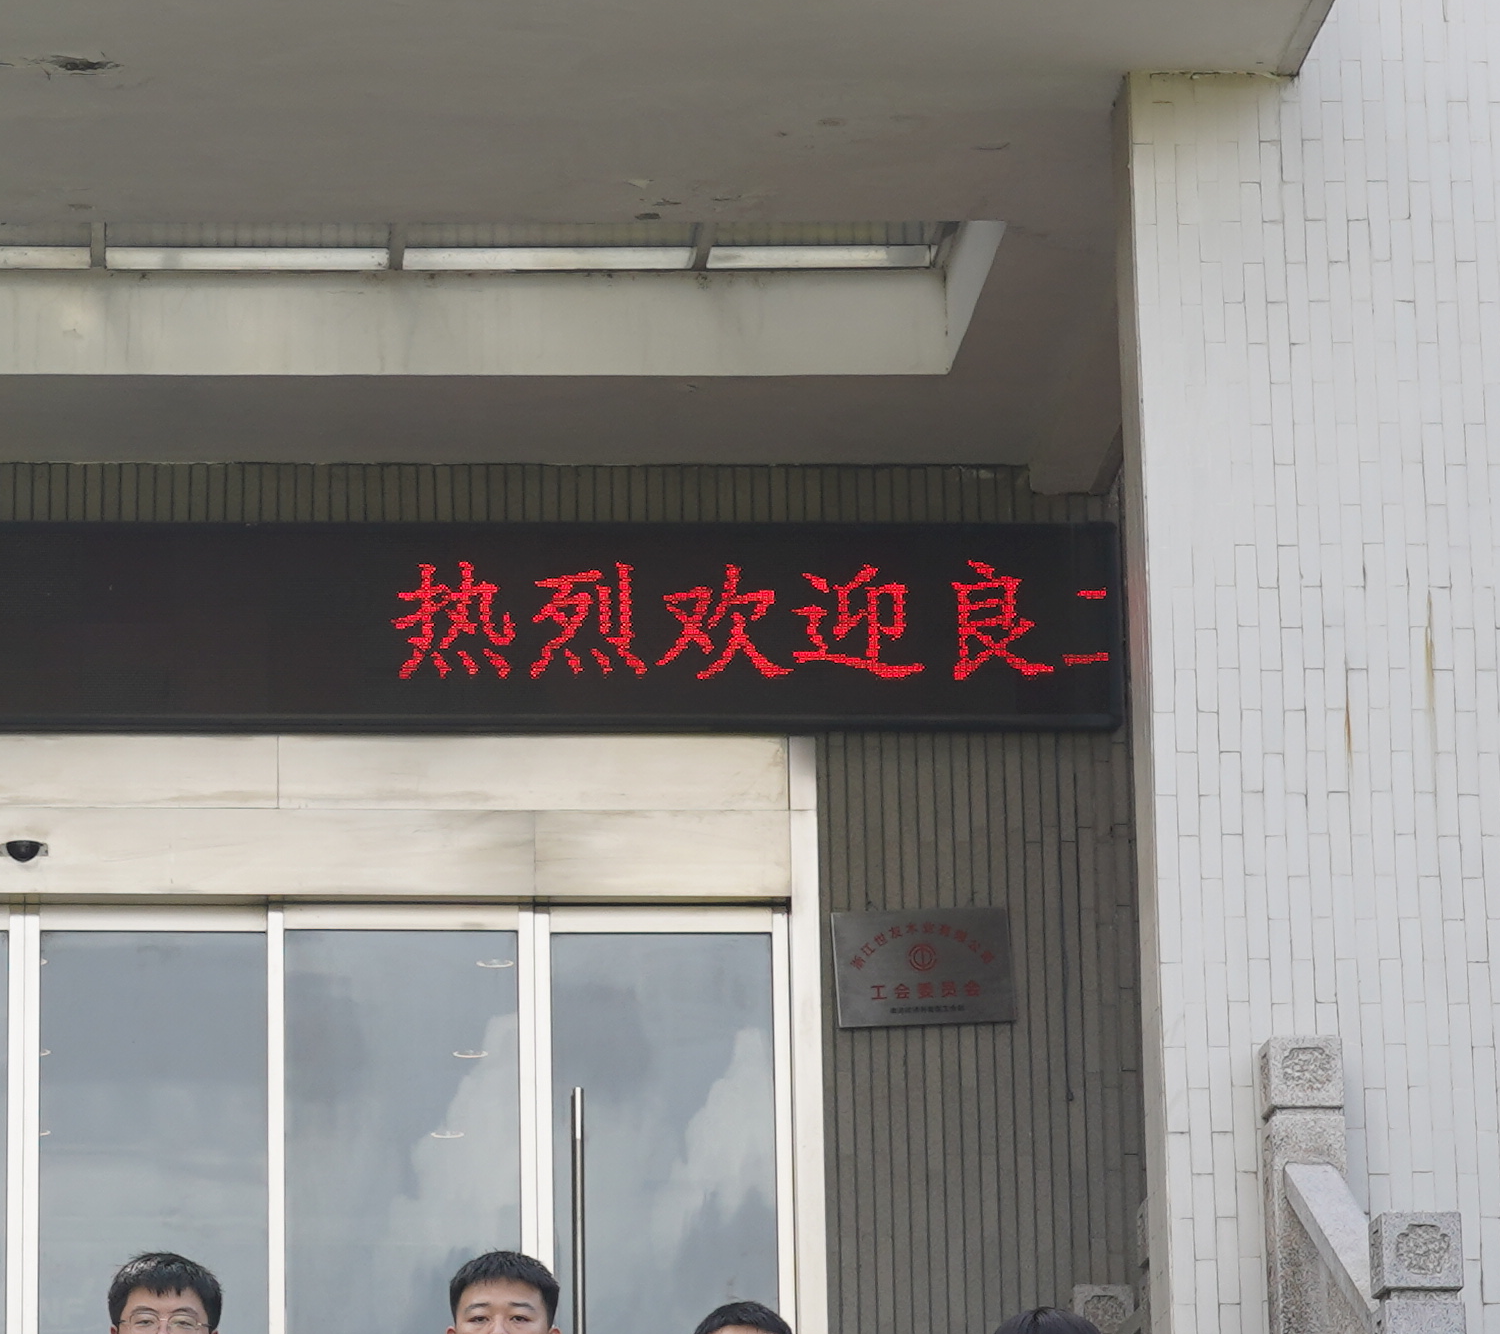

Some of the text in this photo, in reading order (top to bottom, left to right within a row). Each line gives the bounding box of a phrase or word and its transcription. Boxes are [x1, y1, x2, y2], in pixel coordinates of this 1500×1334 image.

[870, 979, 982, 1001] 工会委员会
